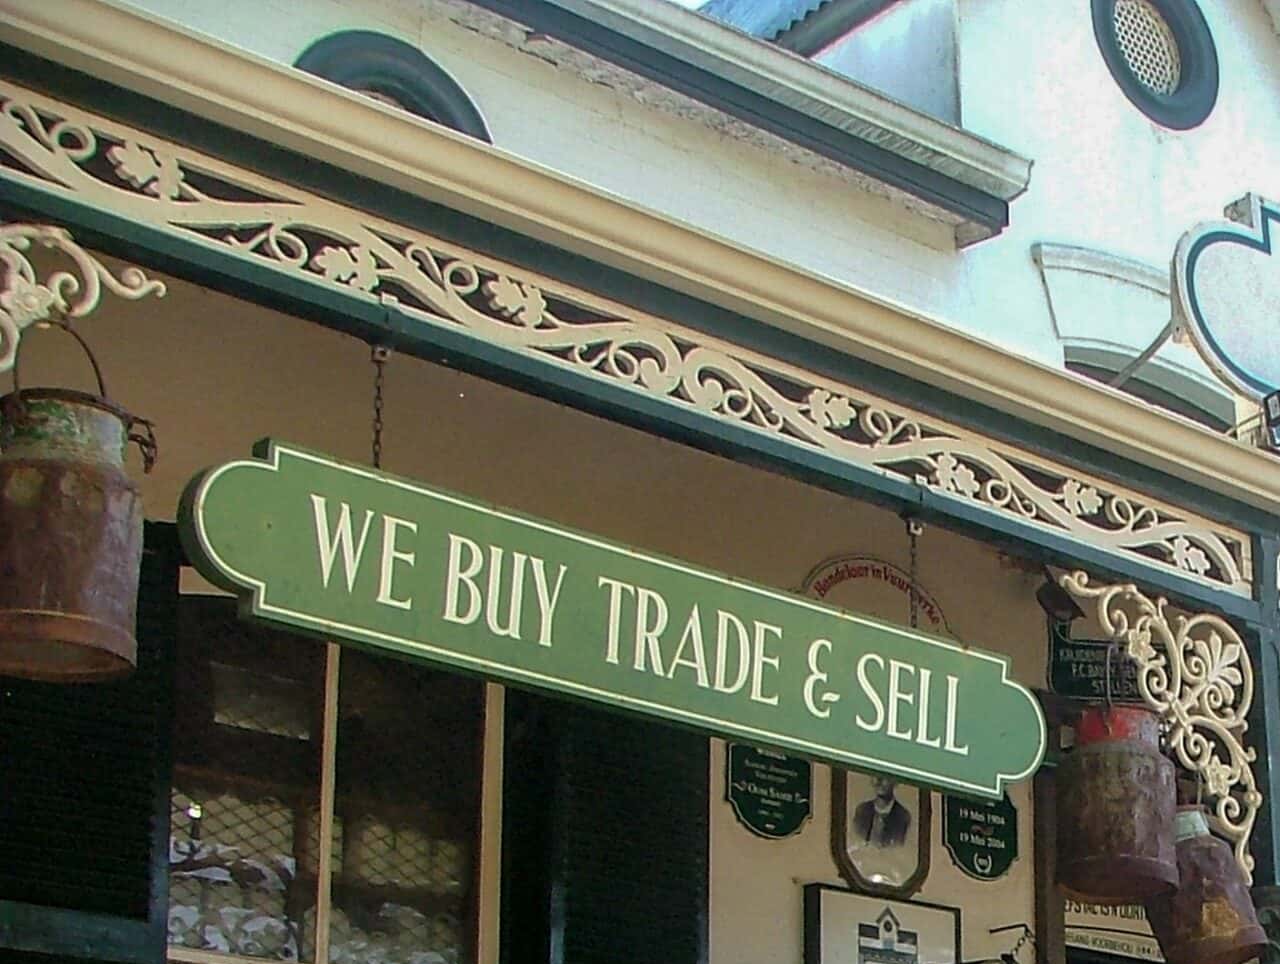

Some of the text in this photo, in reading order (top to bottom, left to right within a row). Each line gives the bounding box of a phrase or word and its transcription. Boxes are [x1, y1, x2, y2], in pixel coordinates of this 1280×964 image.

[310, 494, 969, 755] WE BUY TRADE & SELL
